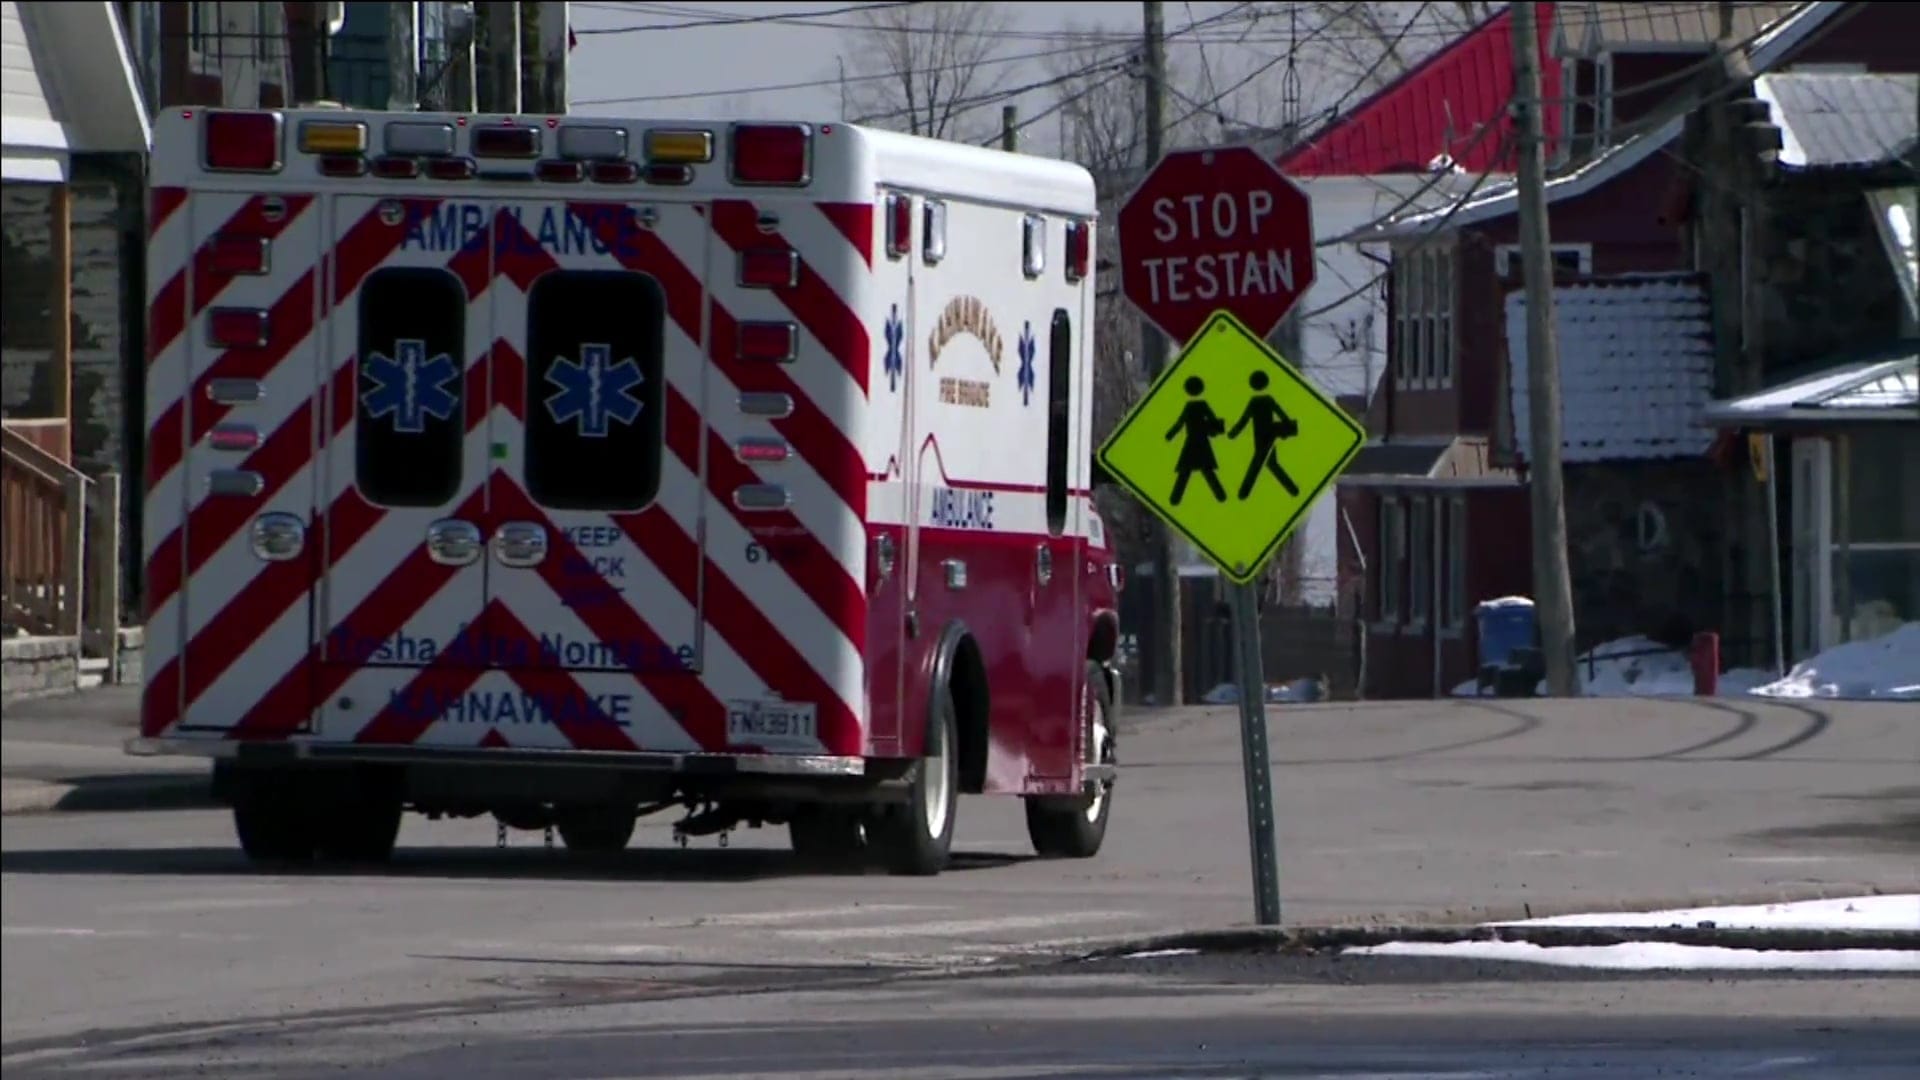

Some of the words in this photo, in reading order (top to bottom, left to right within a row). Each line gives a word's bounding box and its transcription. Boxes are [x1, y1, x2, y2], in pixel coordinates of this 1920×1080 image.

[401, 203, 639, 256] AMBULANCE
[1152, 189, 1274, 243] STOP
[1141, 247, 1295, 305] TESTAN
[931, 487, 993, 529] AMBULANCE
[561, 525, 622, 548] KEEP
[563, 555, 626, 578] CK
[389, 690, 630, 727] KAHNAWAKE
